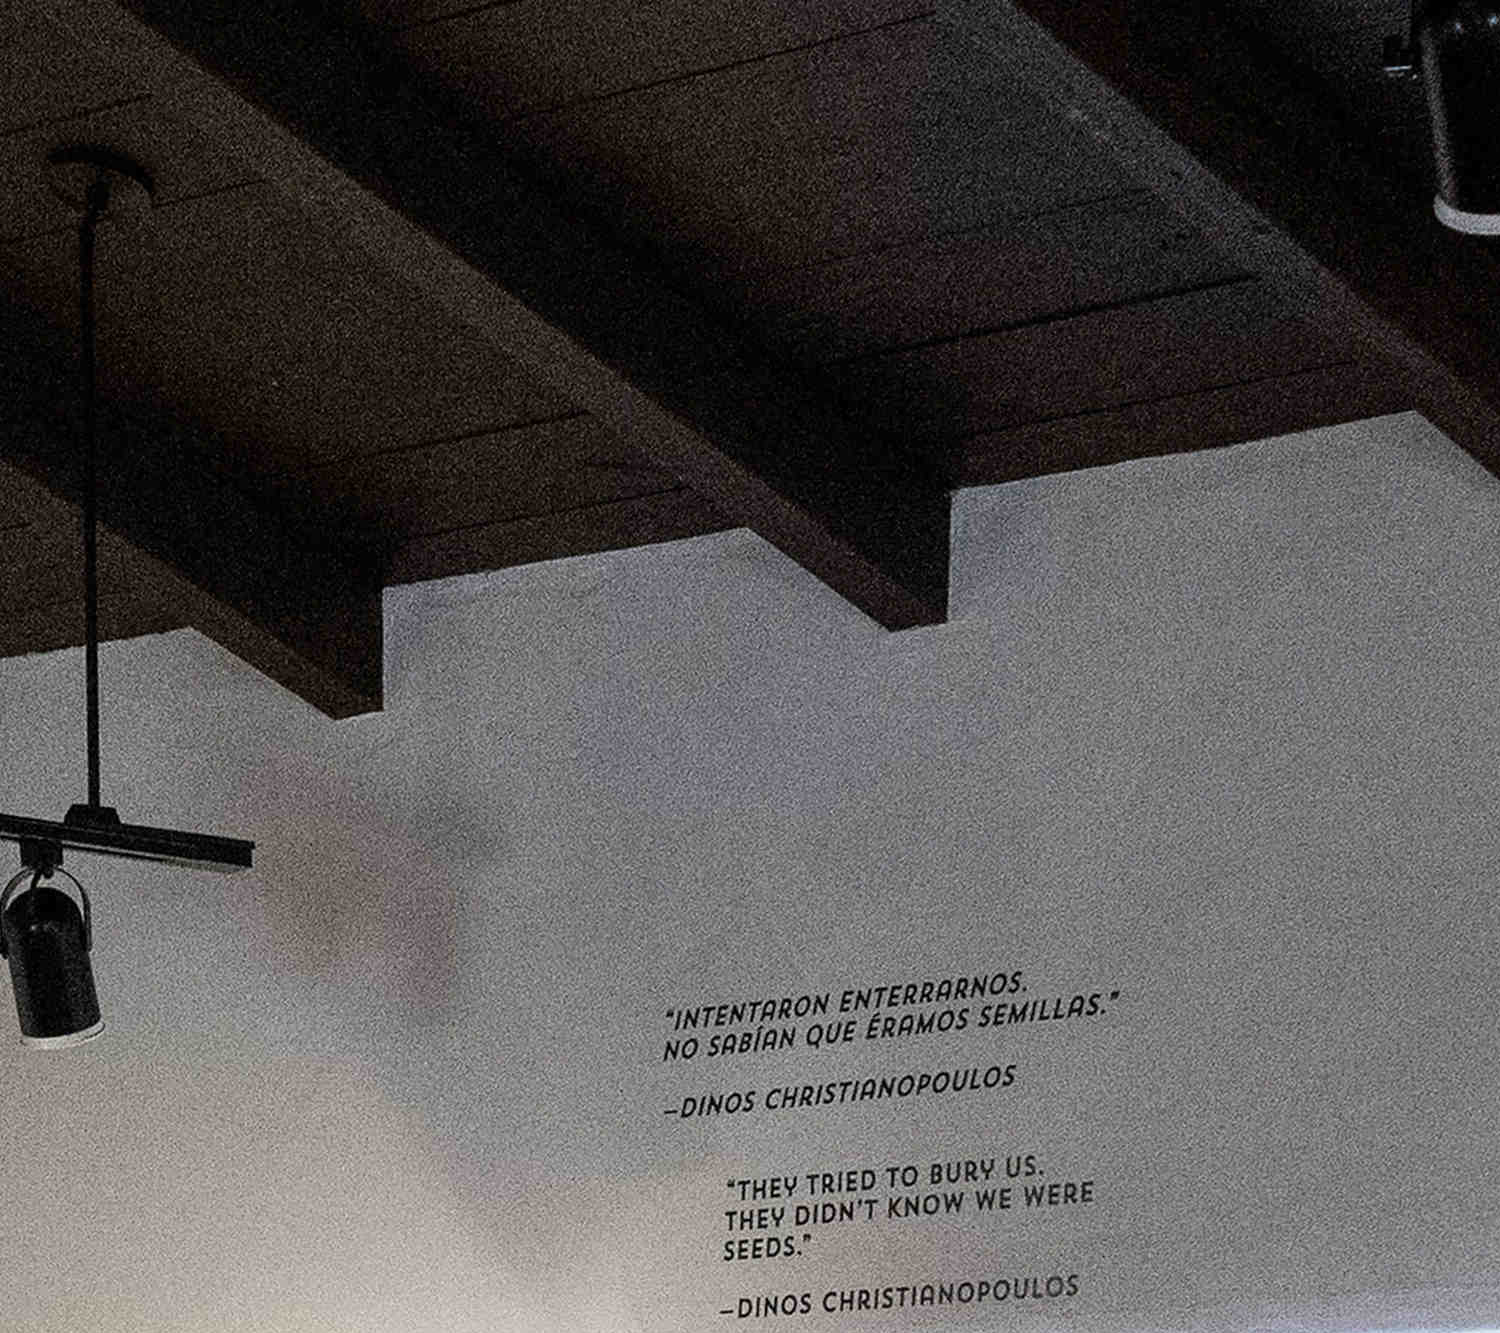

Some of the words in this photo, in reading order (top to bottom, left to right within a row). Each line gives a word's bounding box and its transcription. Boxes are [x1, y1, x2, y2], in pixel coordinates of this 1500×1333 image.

[665, 993, 830, 1031] “INTENTARON
[838, 970, 1029, 1014] ENTERRARNOS.
[663, 1037, 700, 1062] NO
[707, 1025, 797, 1058] SABÍAN
[805, 1019, 857, 1049] QUE
[865, 1007, 970, 1041] ÉRAMOS
[977, 990, 1121, 1028] SEMILLAS.”
[764, 1064, 1017, 1111] CHRISTIANOPOULOS
[726, 1176, 798, 1201] “THEY
[805, 1168, 877, 1196] TRIED
[885, 1165, 919, 1188] TO
[929, 1158, 995, 1186] BURY
[1005, 1154, 1045, 1179] US.
[724, 1207, 785, 1232] THEY
[794, 1198, 879, 1227] DIDN’T
[887, 1192, 965, 1219] KNOW
[975, 1187, 1012, 1211] WE
[1023, 1180, 1095, 1207] WERE
[723, 1233, 812, 1262] SEEDS.”
[821, 1273, 1079, 1314] CHRISTIANOPOULOS
